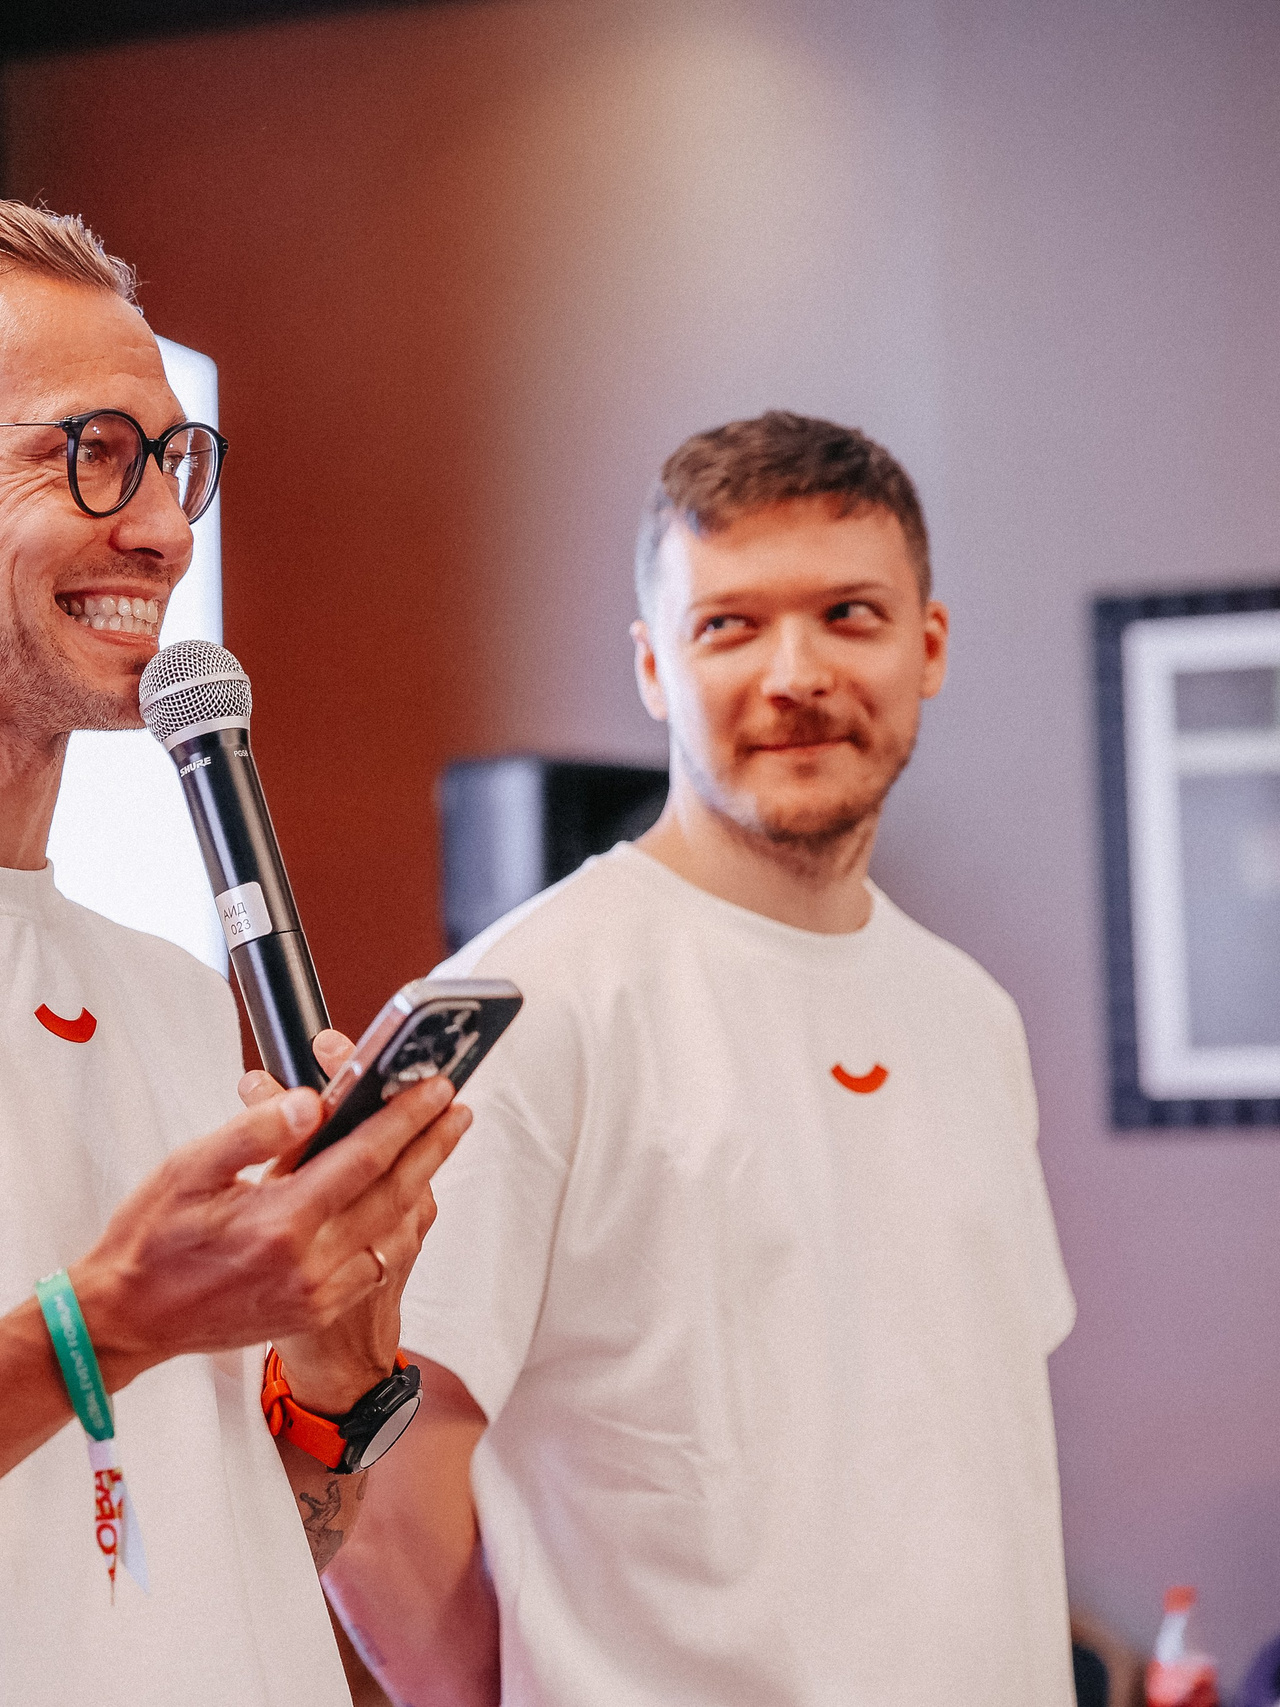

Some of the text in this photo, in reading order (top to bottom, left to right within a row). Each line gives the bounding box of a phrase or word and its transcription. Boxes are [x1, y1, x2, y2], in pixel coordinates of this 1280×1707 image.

[179, 756, 212, 777] SHURE
[223, 902, 247, 922] АИД
[230, 918, 251, 935] 023
